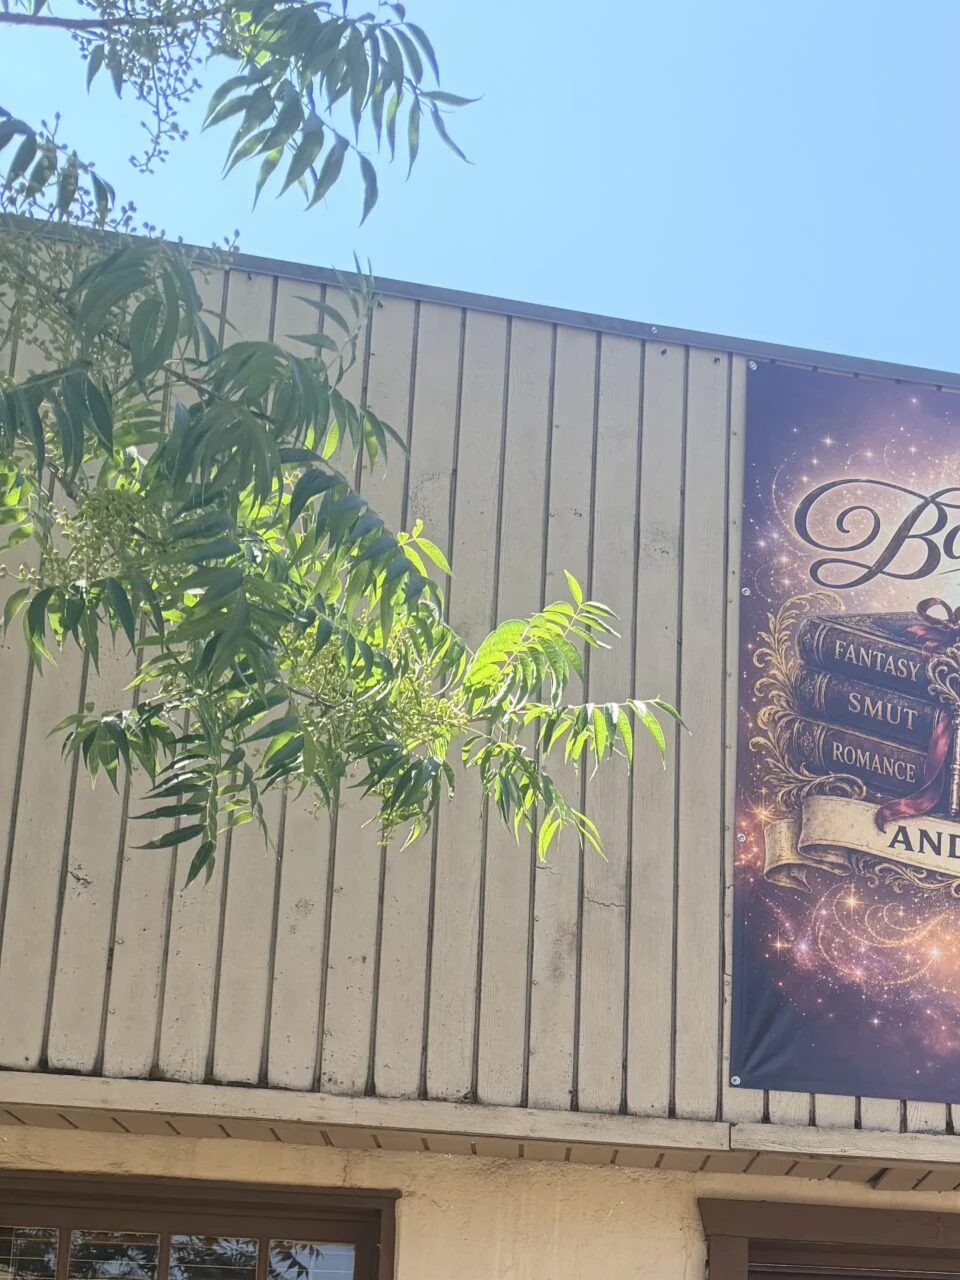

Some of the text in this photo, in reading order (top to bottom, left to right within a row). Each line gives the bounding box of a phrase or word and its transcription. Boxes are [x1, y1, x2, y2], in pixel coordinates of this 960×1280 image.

[833, 640, 921, 682] FANTASY
[847, 691, 918, 731] SMUT
[832, 741, 917, 784] ROMANCE
